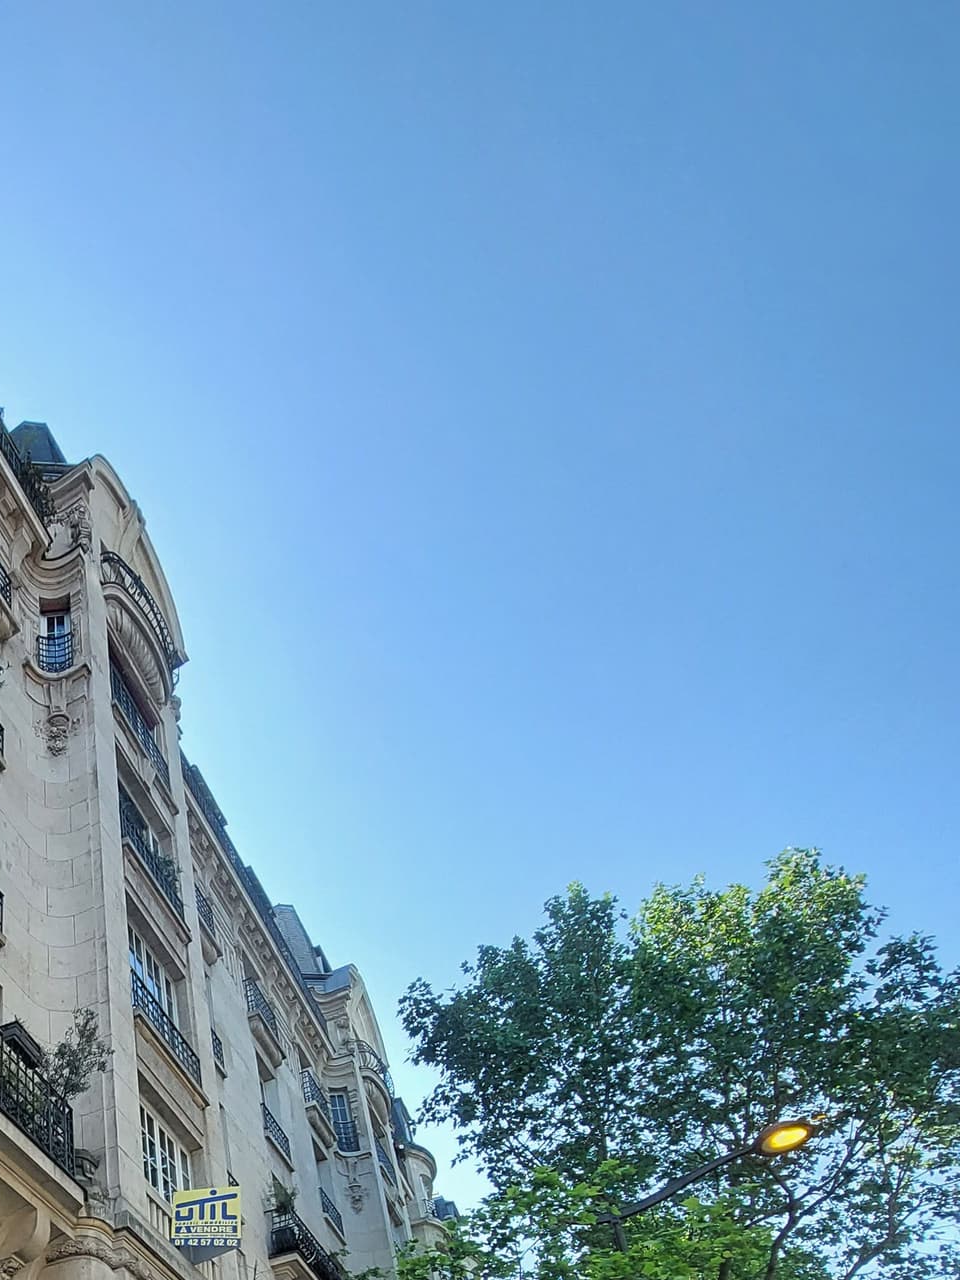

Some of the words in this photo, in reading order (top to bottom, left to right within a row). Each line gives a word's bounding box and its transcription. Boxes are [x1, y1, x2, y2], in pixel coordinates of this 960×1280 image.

[174, 1238, 185, 1246] 01
[187, 1238, 199, 1246] 42
[213, 1238, 225, 1246] 02
[226, 1238, 238, 1246] 02
